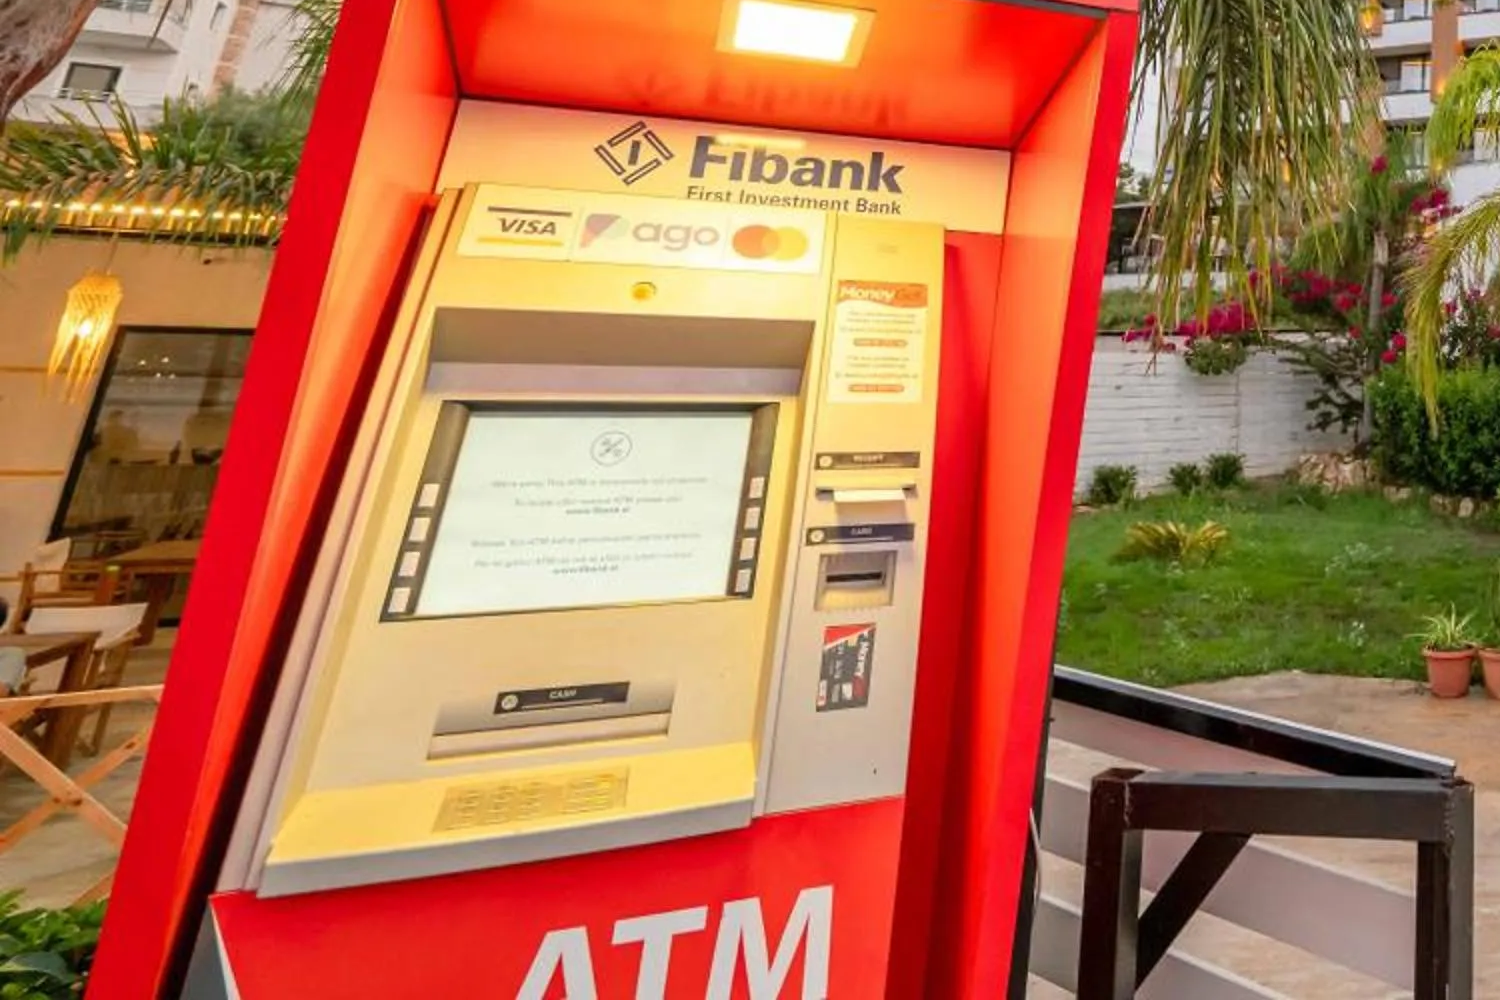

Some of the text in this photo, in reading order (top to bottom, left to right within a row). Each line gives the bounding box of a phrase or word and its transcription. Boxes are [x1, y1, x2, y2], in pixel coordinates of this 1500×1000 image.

[689, 135, 905, 194] Fibank
[687, 185, 902, 215] First Investment Bank
[498, 217, 558, 236] VISA
[631, 221, 720, 252] ago
[515, 884, 834, 1000] ATM
